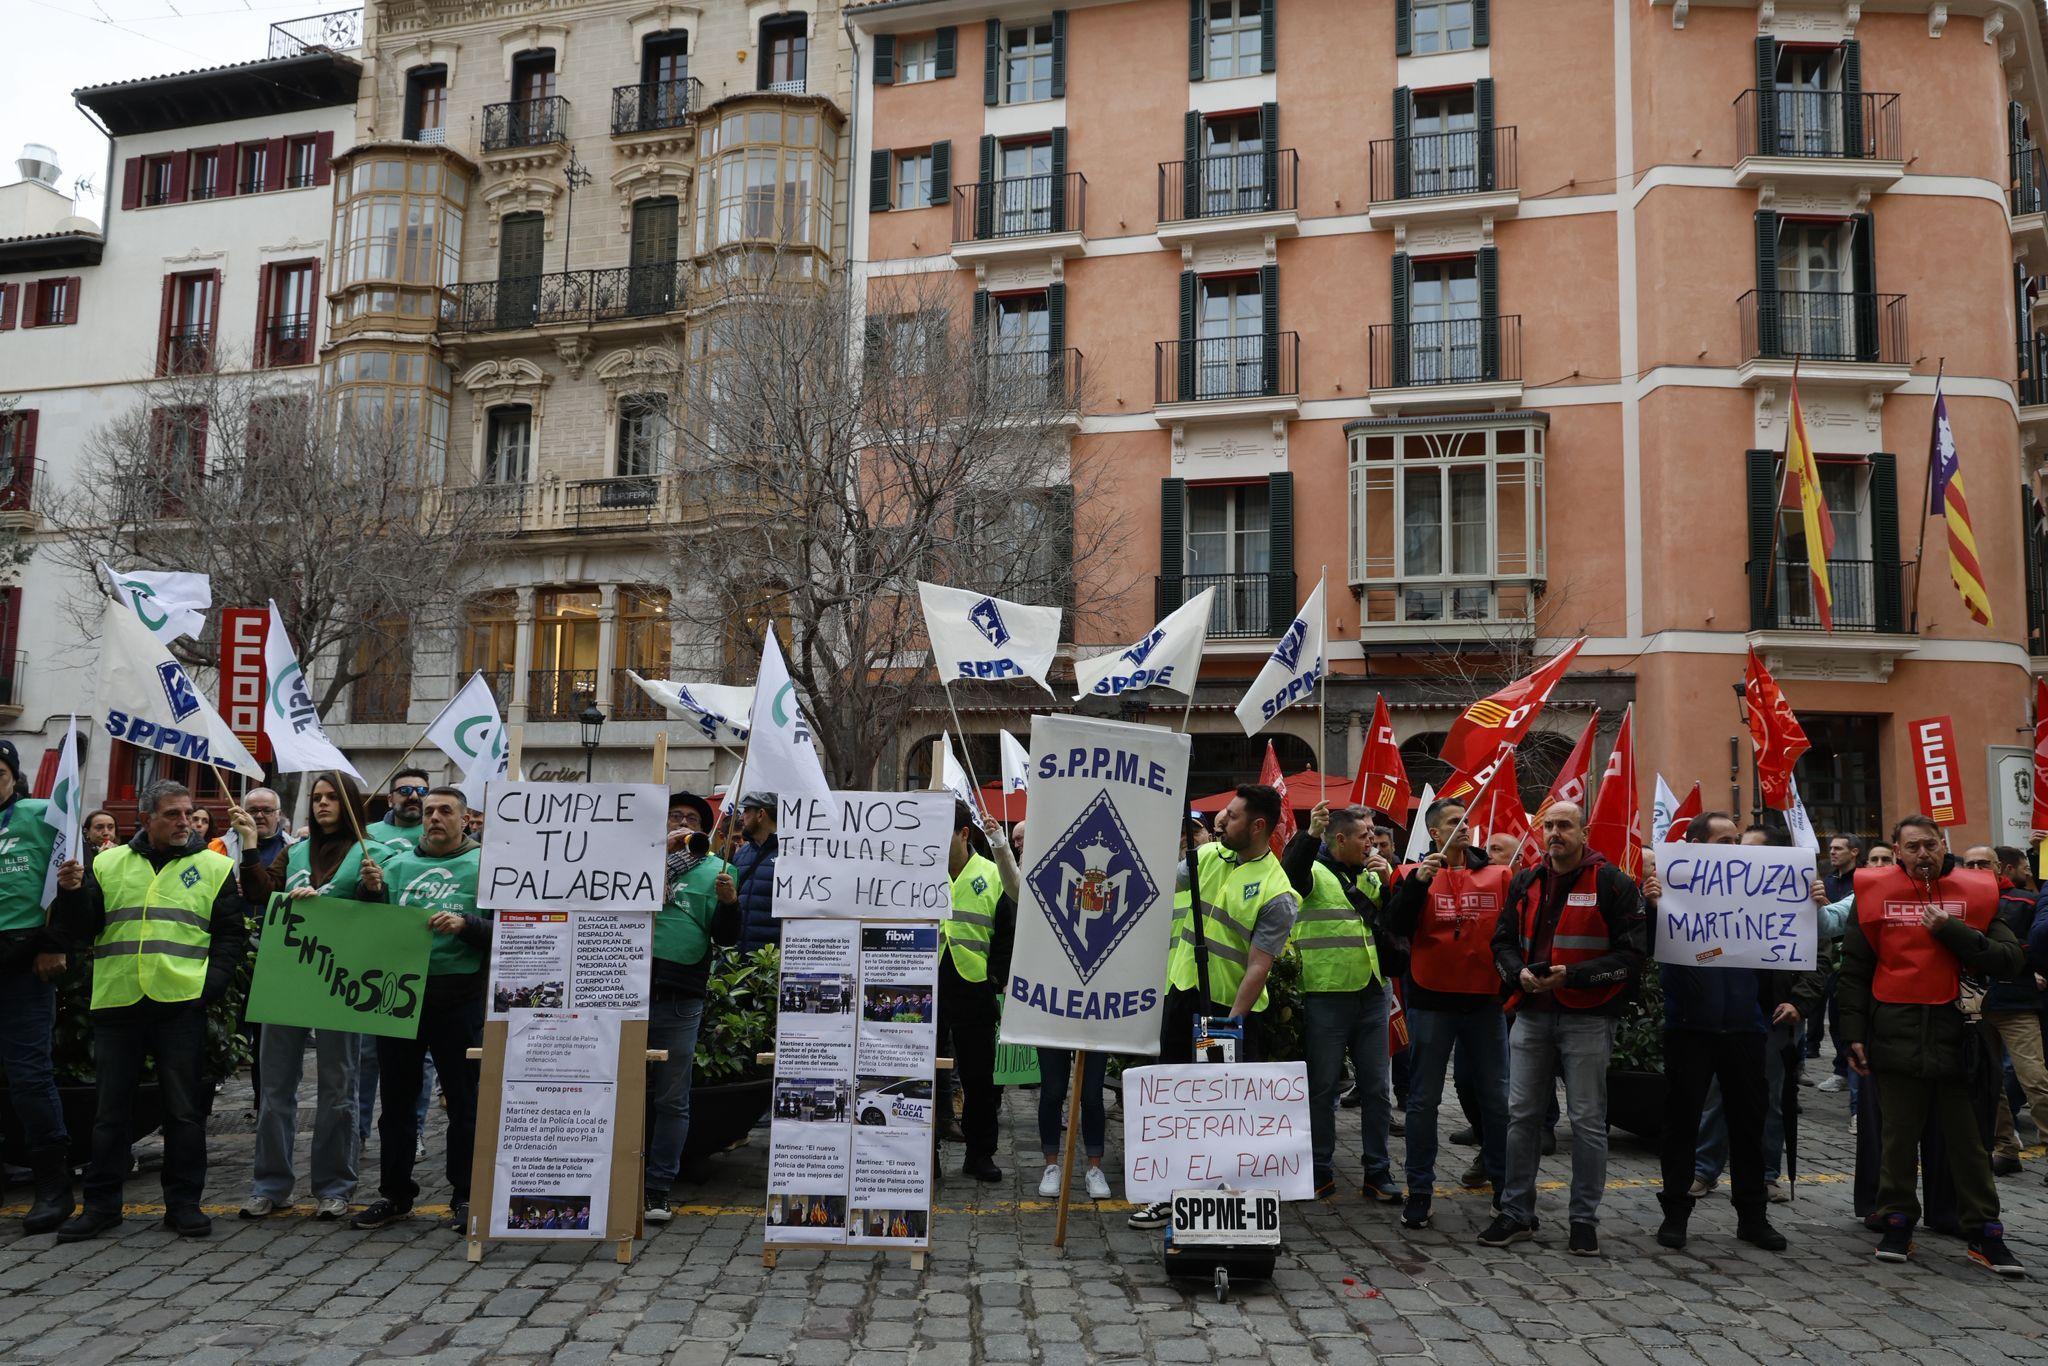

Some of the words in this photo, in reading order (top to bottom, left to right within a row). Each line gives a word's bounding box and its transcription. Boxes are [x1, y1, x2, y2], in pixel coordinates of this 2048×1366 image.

[231, 617, 262, 732] CCOO
[957, 658, 1024, 678] SPP
[529, 762, 586, 782] Cartier
[1038, 747, 1173, 796] S.P.P.M.E.
[1920, 722, 1952, 806] CCOO
[497, 792, 635, 824] CUMPLE
[783, 798, 920, 833] MENOS
[4, 856, 28, 864] ILLES
[537, 831, 587, 862] TU
[779, 836, 940, 867] TITULARES
[0, 865, 30, 874] LEARS
[490, 867, 654, 900] PALABRA
[1667, 859, 1814, 902] CHAPUZAS
[415, 882, 461, 900] CSIF
[442, 902, 464, 910] ILLES
[777, 875, 832, 901] MÁS
[856, 877, 949, 908] HECHOS
[886, 930, 914, 940] fibwi
[1761, 943, 1807, 962] S.L.
[1011, 975, 1157, 1020] BALEARES
[898, 1110, 924, 1118] LOCAL
[1142, 1114, 1292, 1142] ESPERANZA
[539, 1125, 564, 1134] amplio
[1133, 1157, 1168, 1182] EN
[1187, 1155, 1223, 1181] EL
[1237, 1153, 1299, 1178] PLAN
[1175, 1197, 1277, 1230] SPPME-IB
